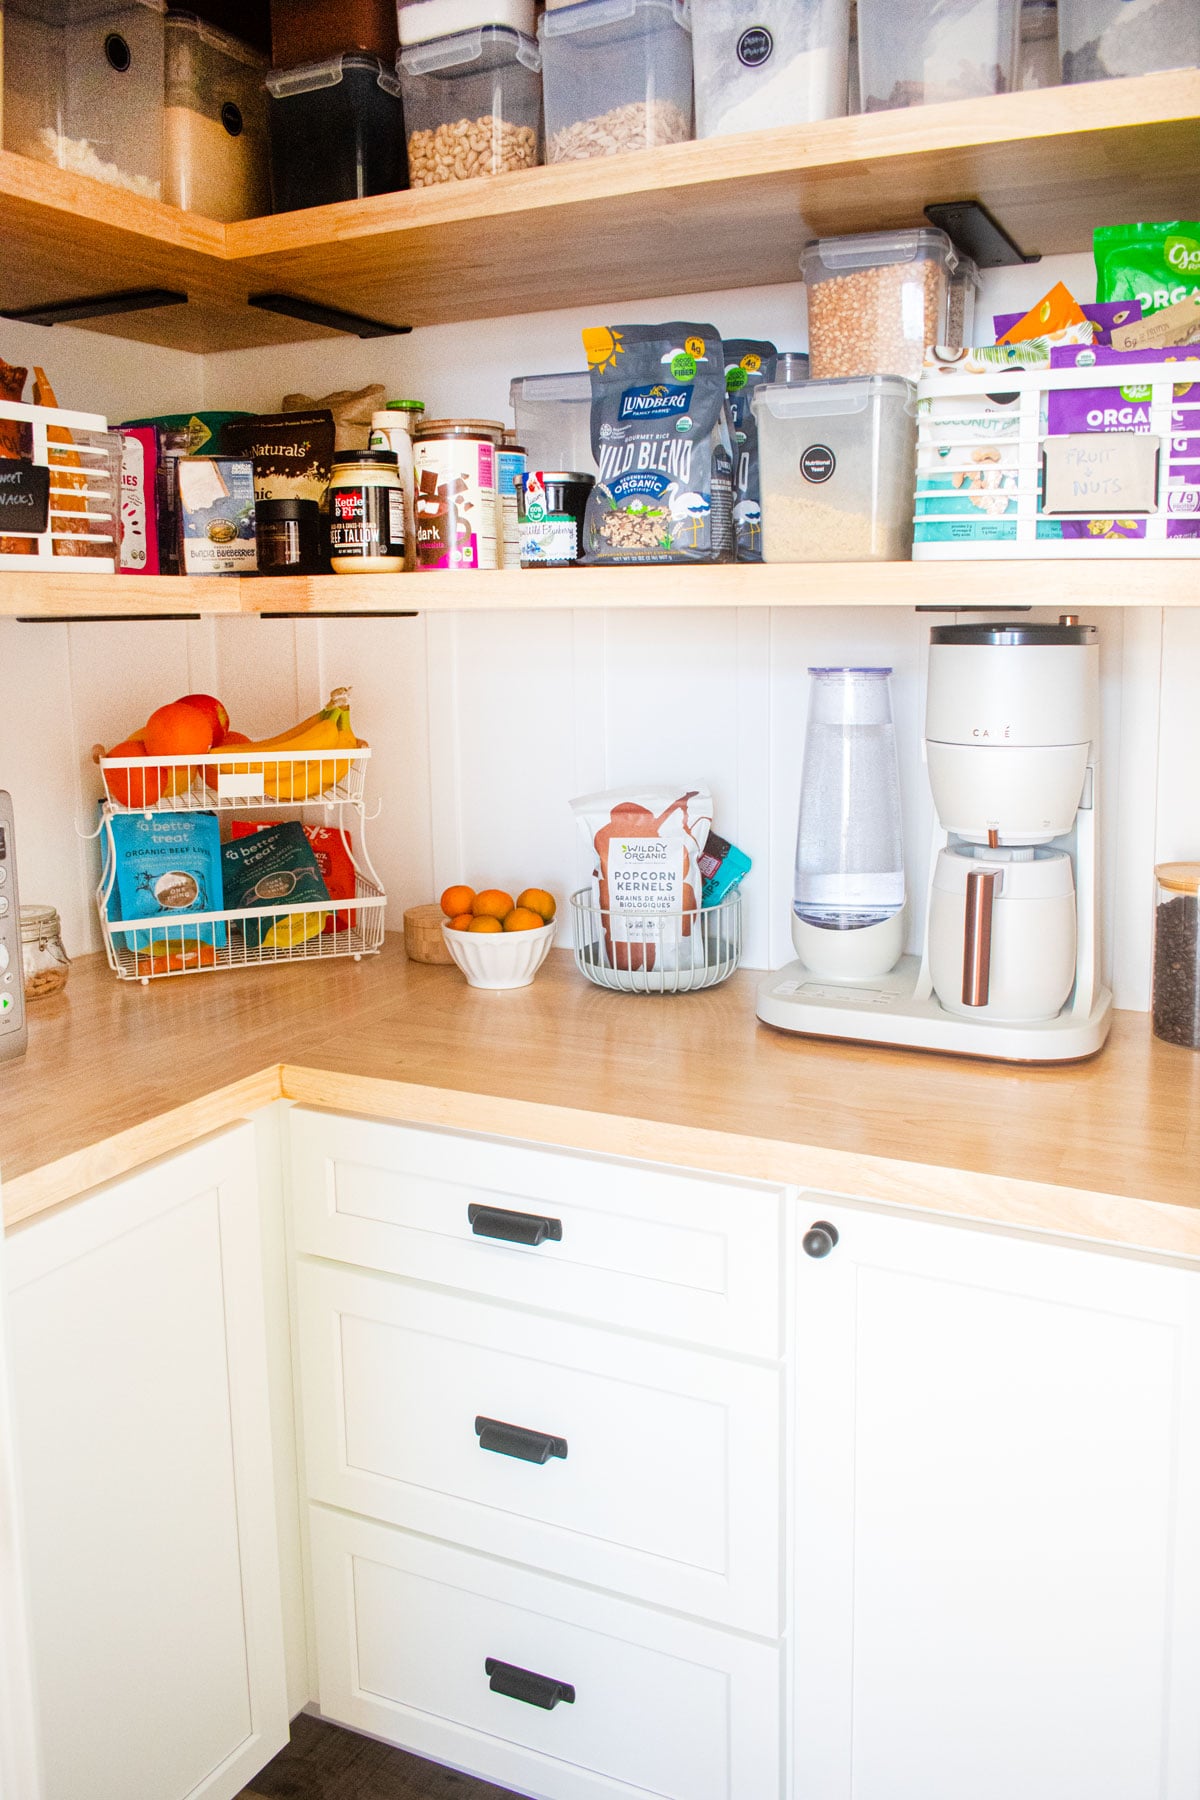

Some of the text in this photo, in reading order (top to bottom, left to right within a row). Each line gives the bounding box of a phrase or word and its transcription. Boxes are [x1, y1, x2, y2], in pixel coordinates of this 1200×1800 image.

[691, 342, 701, 355] 4g
[674, 369, 694, 377] FIBER
[622, 392, 687, 418] LUNDBERG
[625, 434, 654, 443] GOURMET
[638, 439, 694, 485] BLEND
[1065, 447, 1118, 467] FRUIT
[0, 471, 23, 484] WEET
[614, 479, 663, 494] ORGANIC
[1072, 477, 1122, 497] NUTS
[0, 493, 34, 506] NACKS
[334, 496, 363, 508] Kettle
[335, 506, 363, 517] & Fire
[344, 528, 380, 543] TALLOW
[417, 525, 441, 541] dark
[152, 819, 196, 832] better
[151, 833, 189, 844] treat
[239, 832, 281, 857] better
[125, 848, 166, 858] ORGANIC
[169, 846, 189, 855] BEEF
[627, 842, 668, 853] WILDLY
[243, 843, 277, 866] treat
[624, 852, 667, 862] ORGANIC
[614, 871, 676, 881] POPCORN
[170, 887, 186, 895] ONE
[617, 882, 673, 891] KERNELS
[167, 892, 190, 901] THING
[619, 901, 671, 909] BIOLOGIQUES
